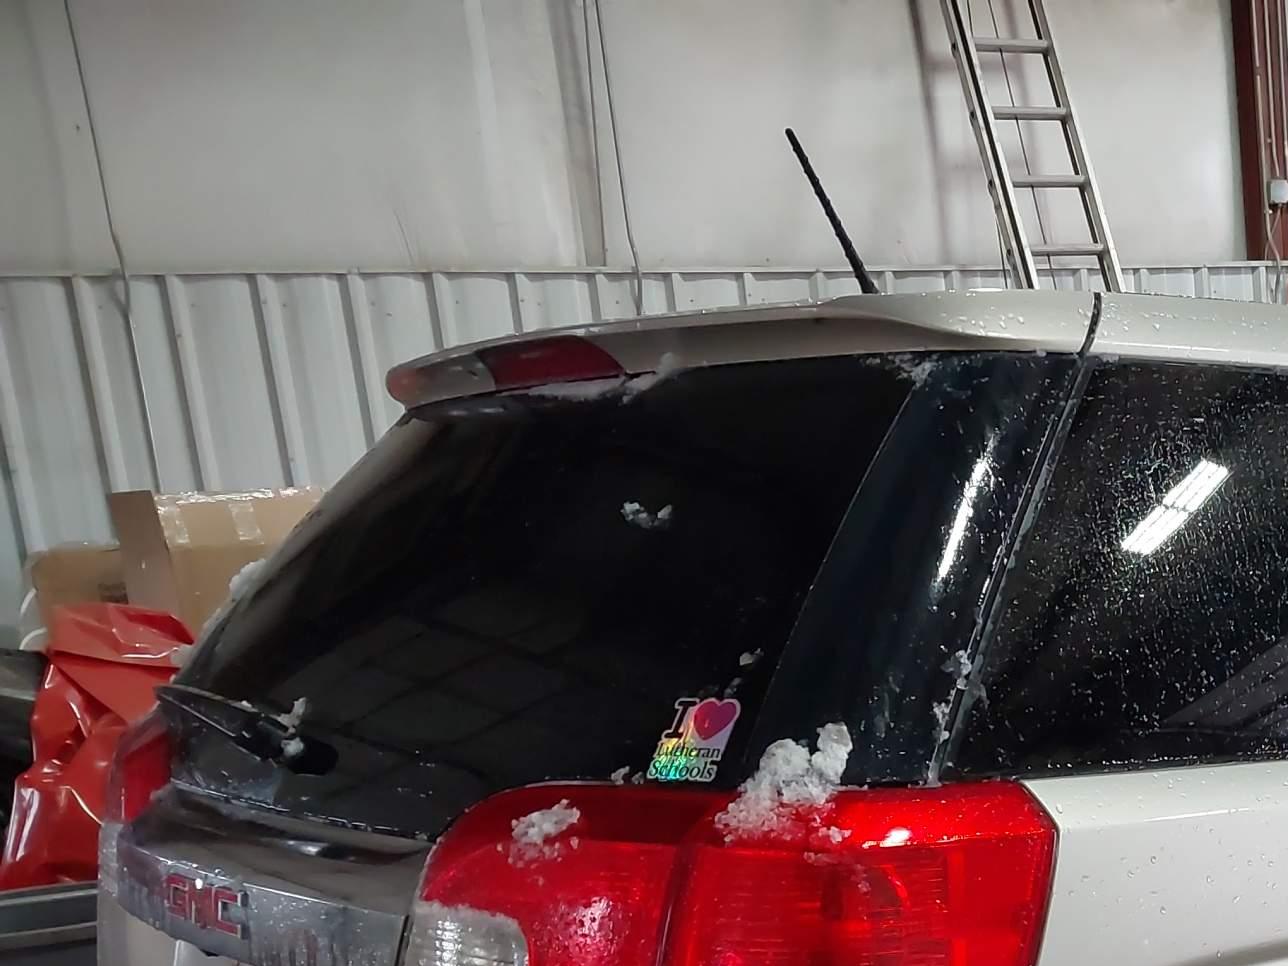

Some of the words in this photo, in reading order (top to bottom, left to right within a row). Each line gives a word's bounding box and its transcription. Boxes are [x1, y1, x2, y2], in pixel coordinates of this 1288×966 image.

[655, 742, 721, 759] Lutheran
[648, 758, 715, 781] Schools
[166, 873, 243, 938] GMC
